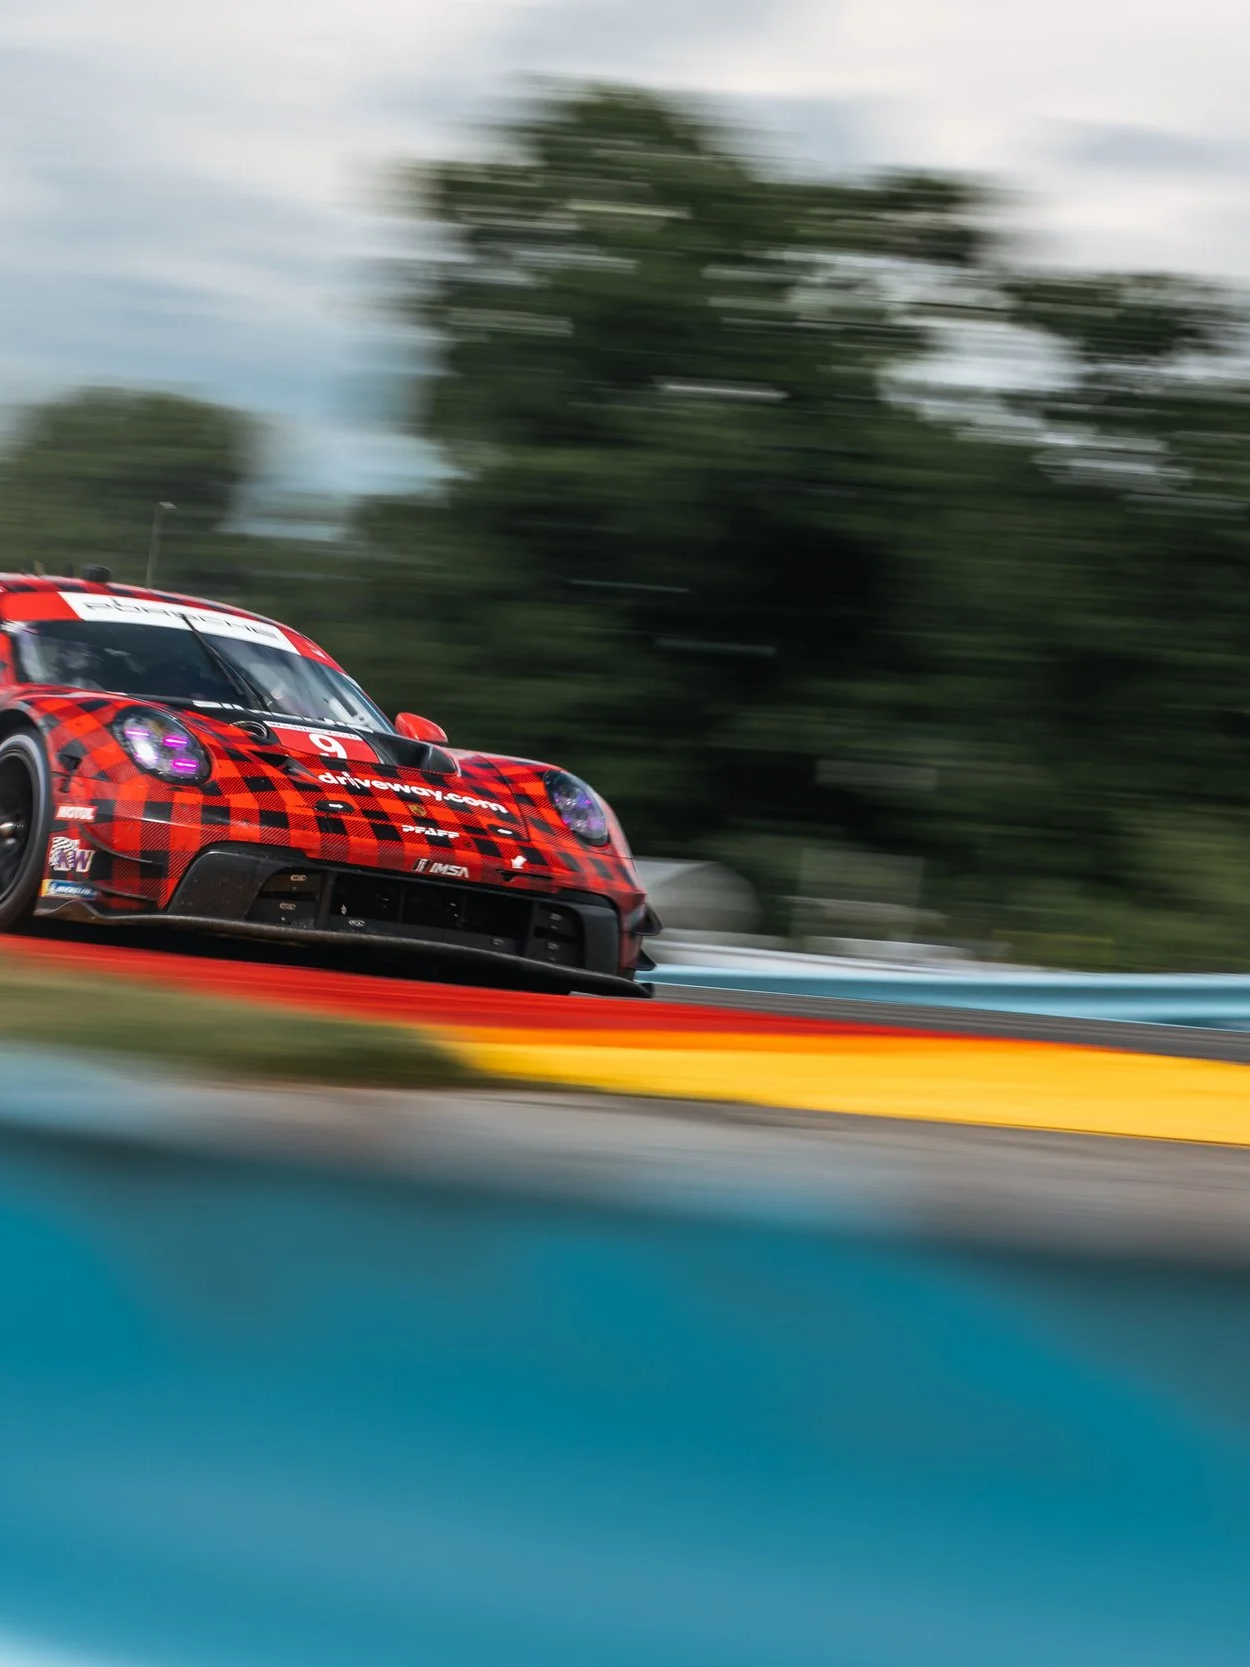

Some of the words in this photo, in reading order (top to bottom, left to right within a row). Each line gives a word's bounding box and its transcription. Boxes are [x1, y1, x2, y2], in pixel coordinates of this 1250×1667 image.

[308, 732, 348, 759] 9
[318, 771, 509, 814] driveway.com
[401, 824, 460, 839] PFAFF
[429, 862, 470, 878] IMSA
